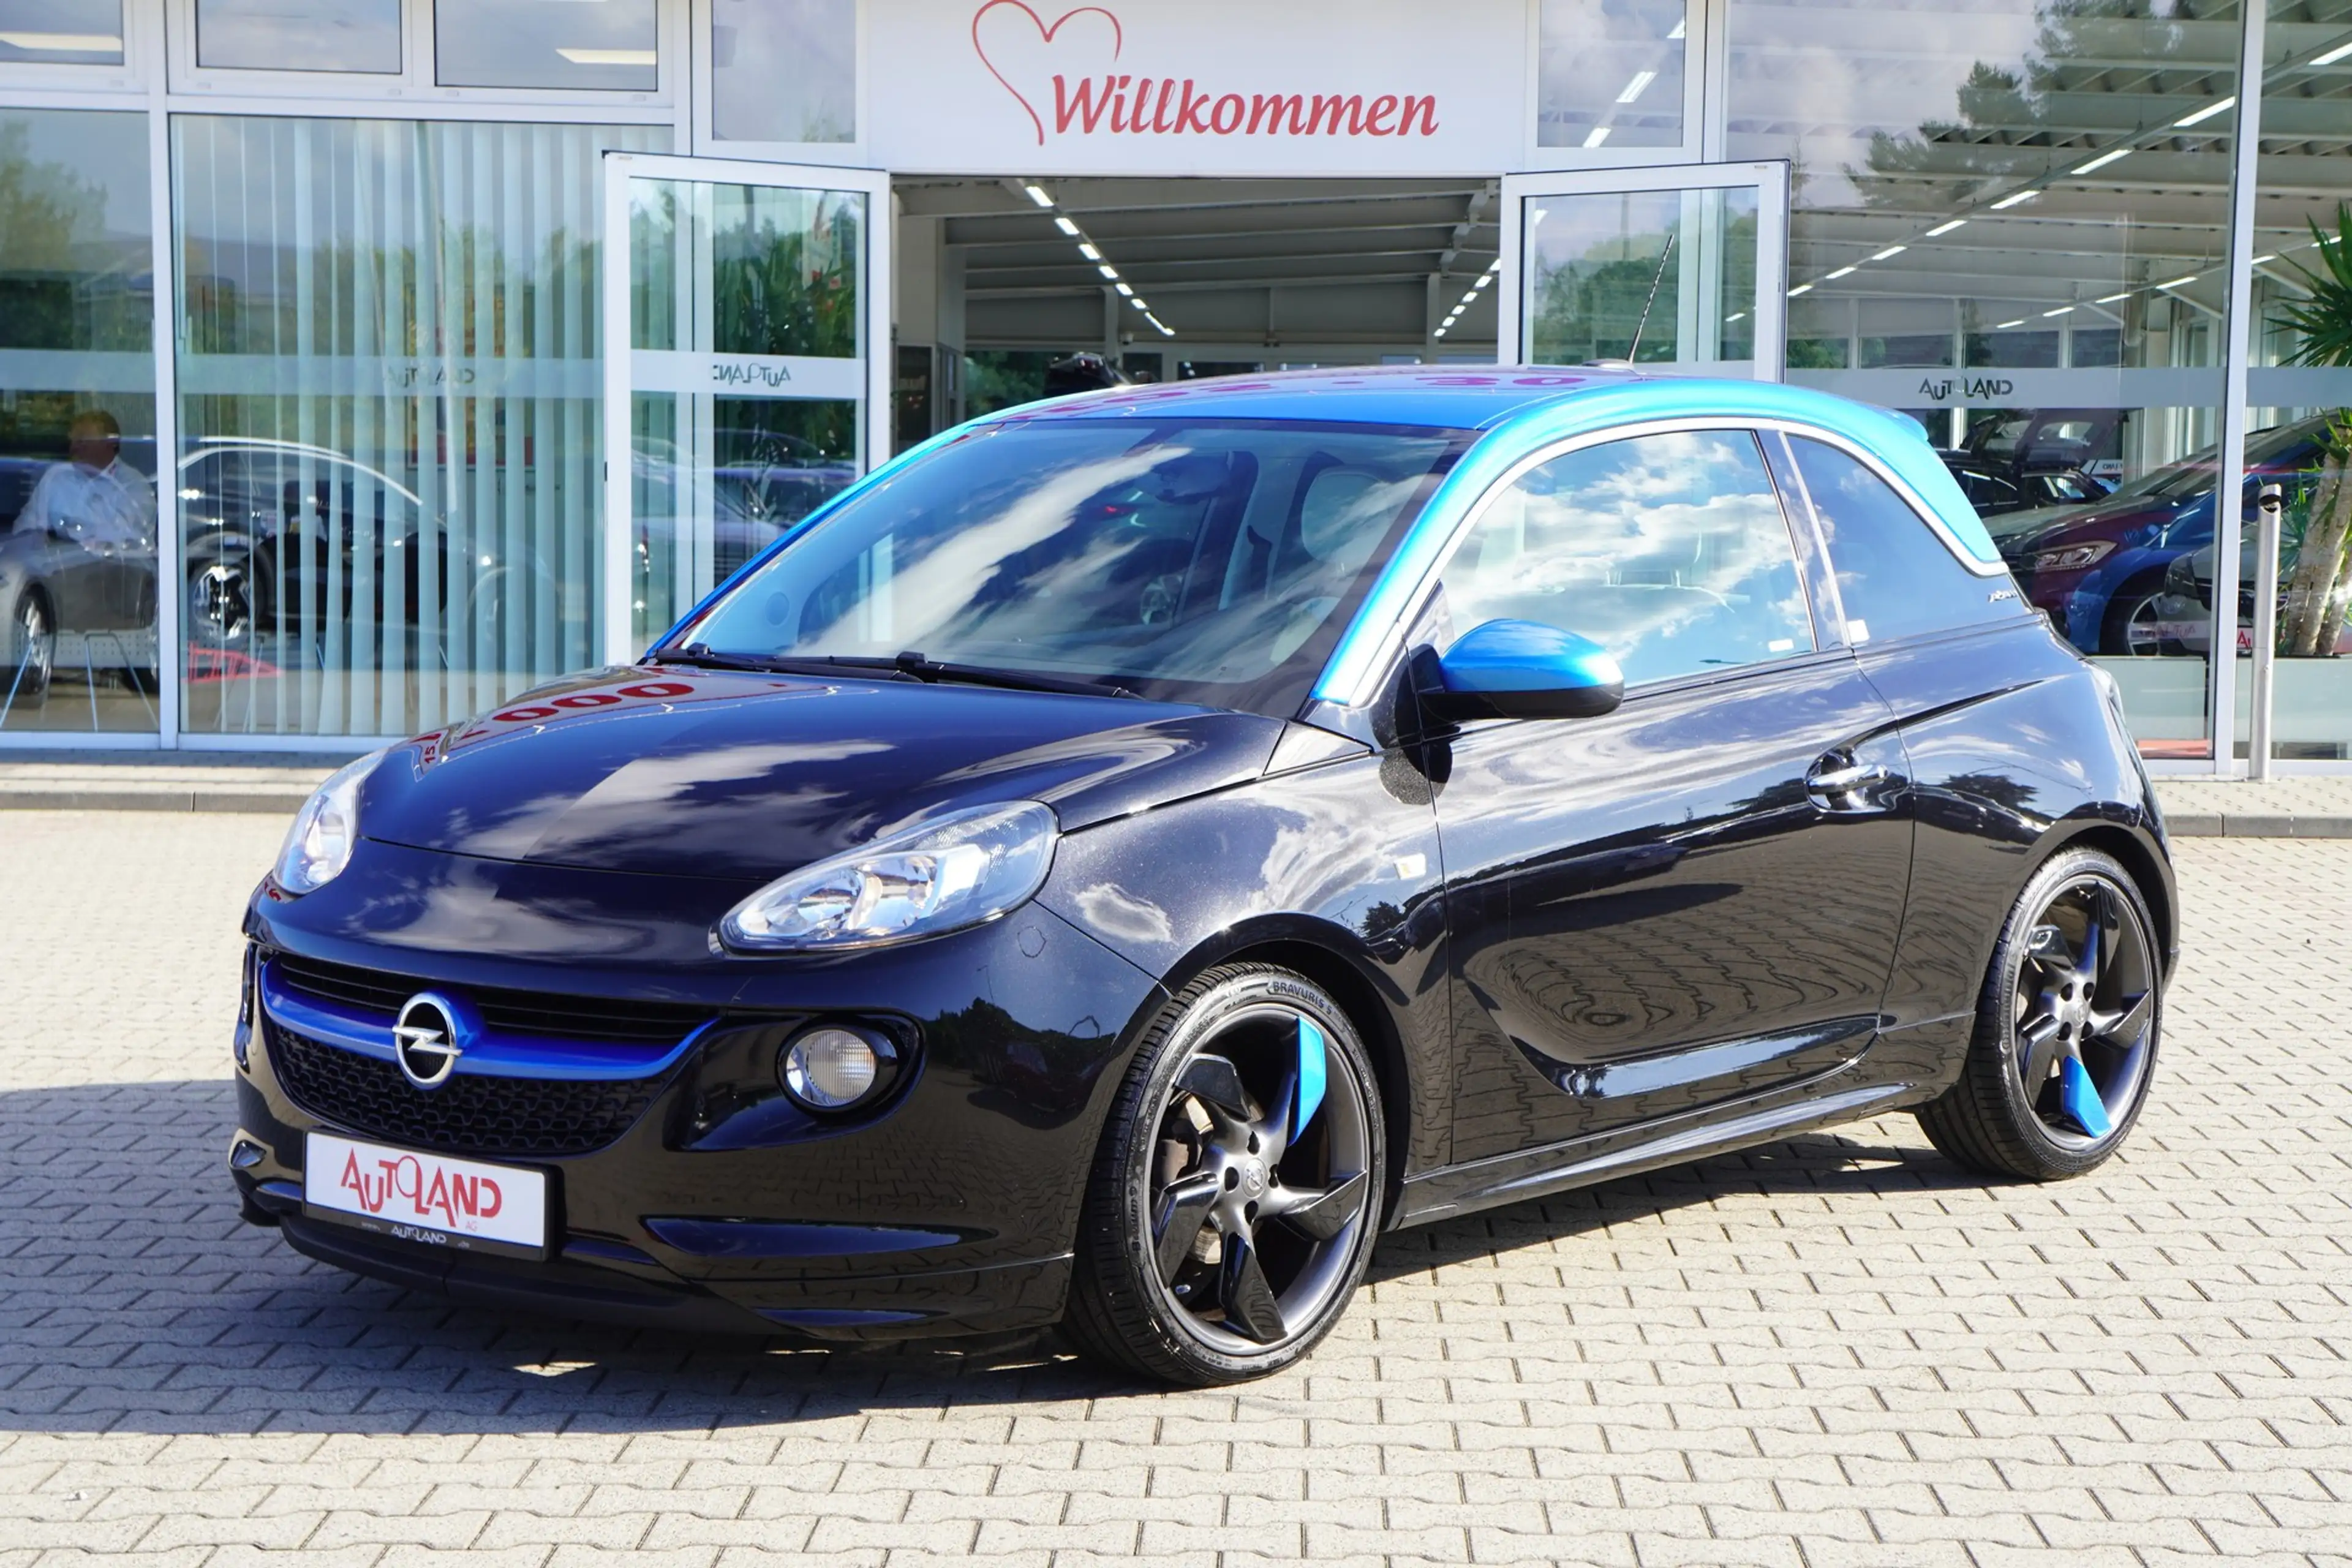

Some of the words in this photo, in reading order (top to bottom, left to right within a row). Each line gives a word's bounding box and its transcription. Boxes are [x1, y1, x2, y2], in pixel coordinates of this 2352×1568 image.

[1052, 74, 1437, 136] Willkommen
[1273, 981, 1325, 1009] BRAVURIS
[341, 1147, 502, 1227] AUTOLAND
[390, 1226, 447, 1244] AUTOLAND
